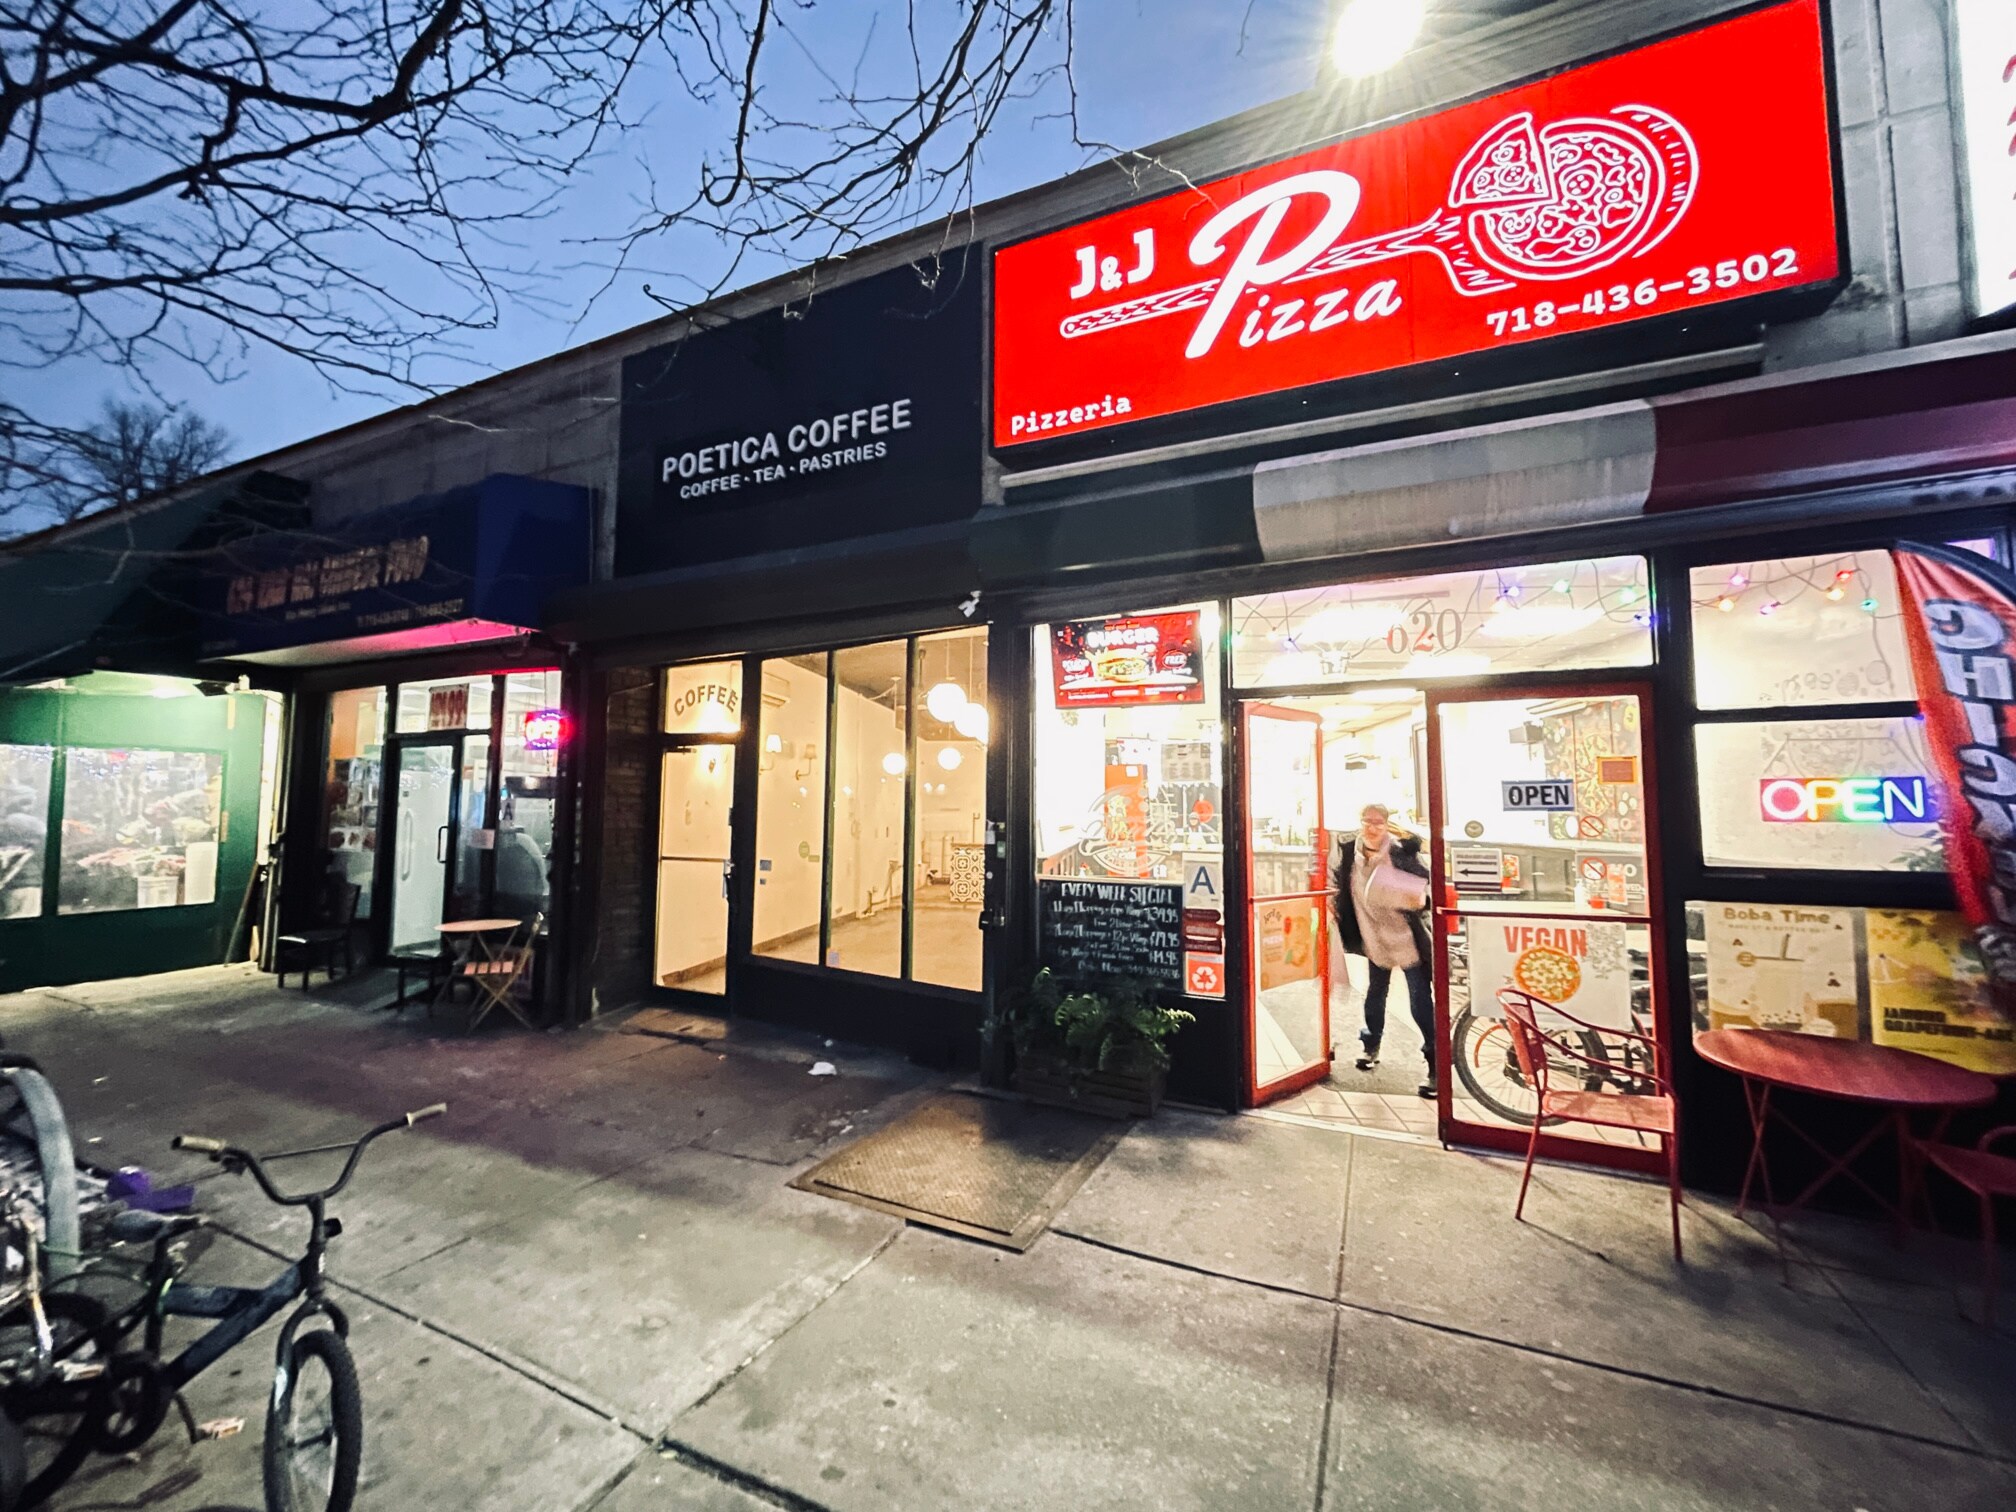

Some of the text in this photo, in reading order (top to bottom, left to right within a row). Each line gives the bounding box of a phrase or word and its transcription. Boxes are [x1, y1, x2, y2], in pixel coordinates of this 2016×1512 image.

[1070, 228, 1155, 300] J&J
[1185, 170, 1403, 359] Pizza
[1486, 247, 1799, 336] 718-436-3502
[1011, 394, 1132, 436] Pizzeria
[662, 398, 912, 483] POETICA COFFEE
[680, 441, 888, 499] COFFEE TEA PASTRIES
[674, 684, 739, 716] COFFEE
[1508, 785, 1570, 806] OPEN
[1762, 778, 1925, 821] OPEN
[1190, 866, 1215, 895] A
[1724, 907, 1830, 924] Boba Time
[1503, 926, 1588, 957] VEGAN
